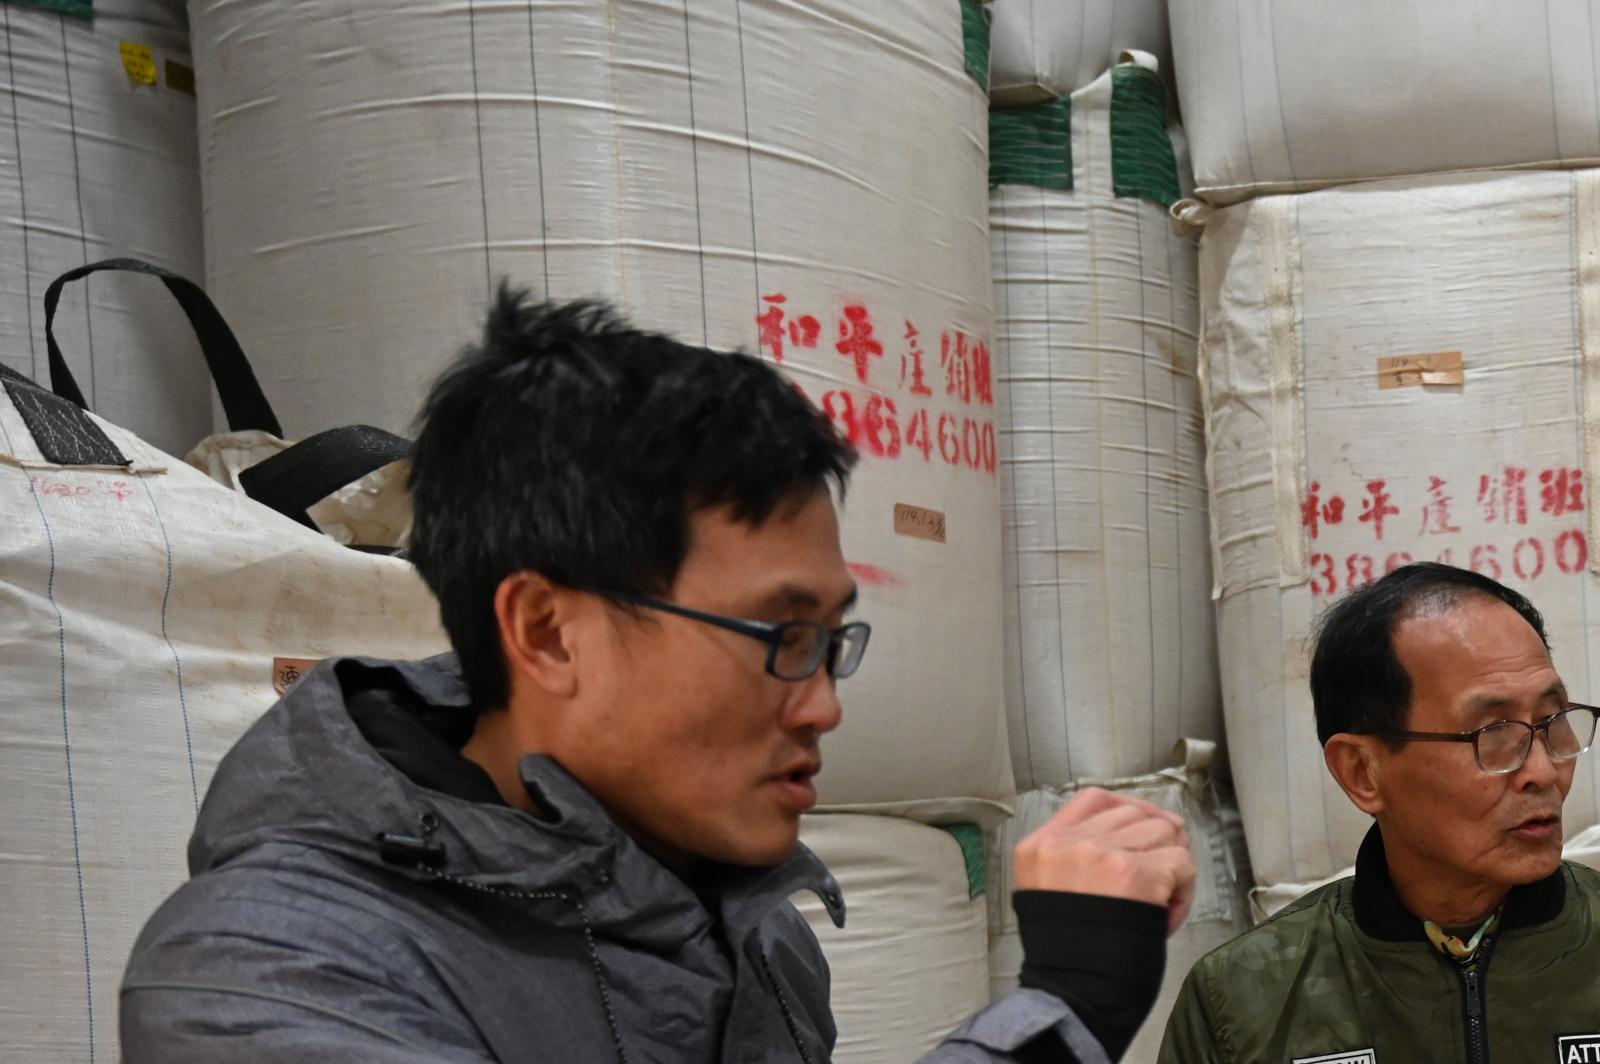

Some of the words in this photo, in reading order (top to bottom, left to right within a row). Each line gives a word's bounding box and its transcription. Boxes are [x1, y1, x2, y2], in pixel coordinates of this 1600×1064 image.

[793, 384, 997, 474] 864600
[1300, 463, 1585, 540] 和平產銷班
